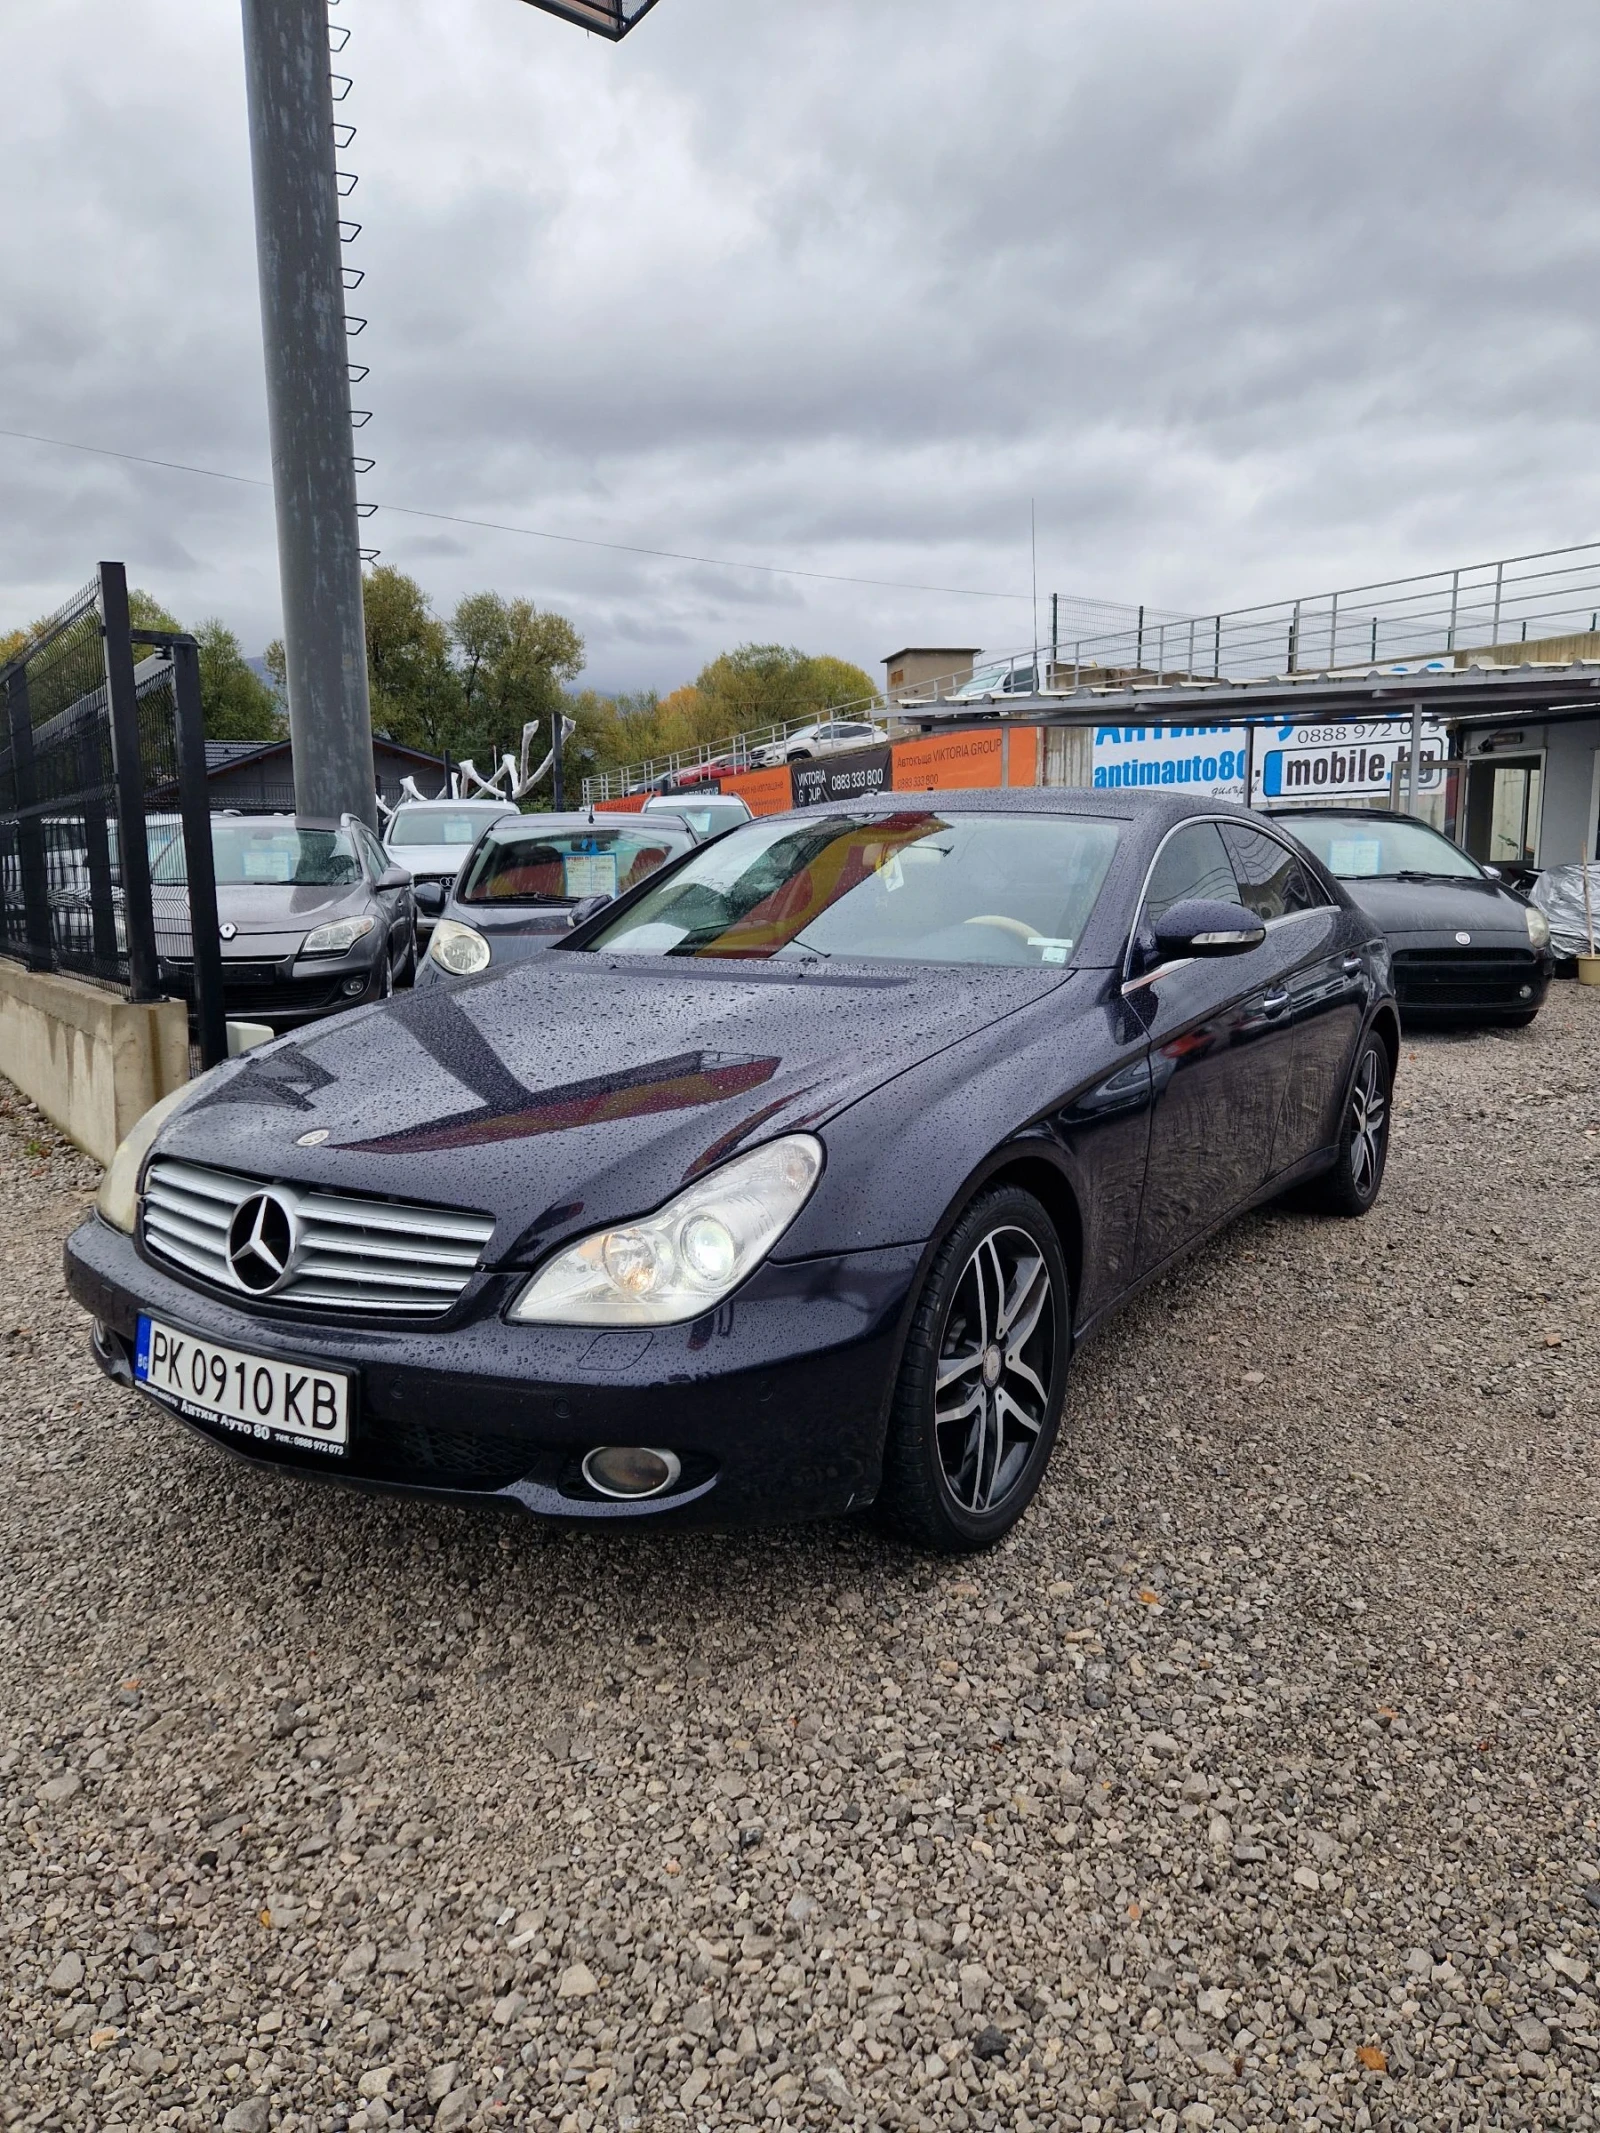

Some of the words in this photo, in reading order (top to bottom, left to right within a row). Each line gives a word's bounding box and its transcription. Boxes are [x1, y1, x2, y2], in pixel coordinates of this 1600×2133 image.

[1297, 726, 1347, 744] 0888
[1353, 722, 1392, 739] 972
[932, 744, 969, 762] VIKTORIA
[970, 738, 1003, 756] GROUP
[797, 769, 827, 788] VIKTORIA
[831, 773, 851, 791] 0883
[851, 770, 866, 788] 333
[866, 767, 884, 786] 800
[137, 1353, 148, 1370] BG
[152, 1330, 184, 1389] PK
[191, 1348, 273, 1416] 0910
[284, 1372, 338, 1431] KB
[181, 1399, 218, 1423] Антим
[220, 1415, 252, 1435] Ауто
[253, 1424, 270, 1440] 80
